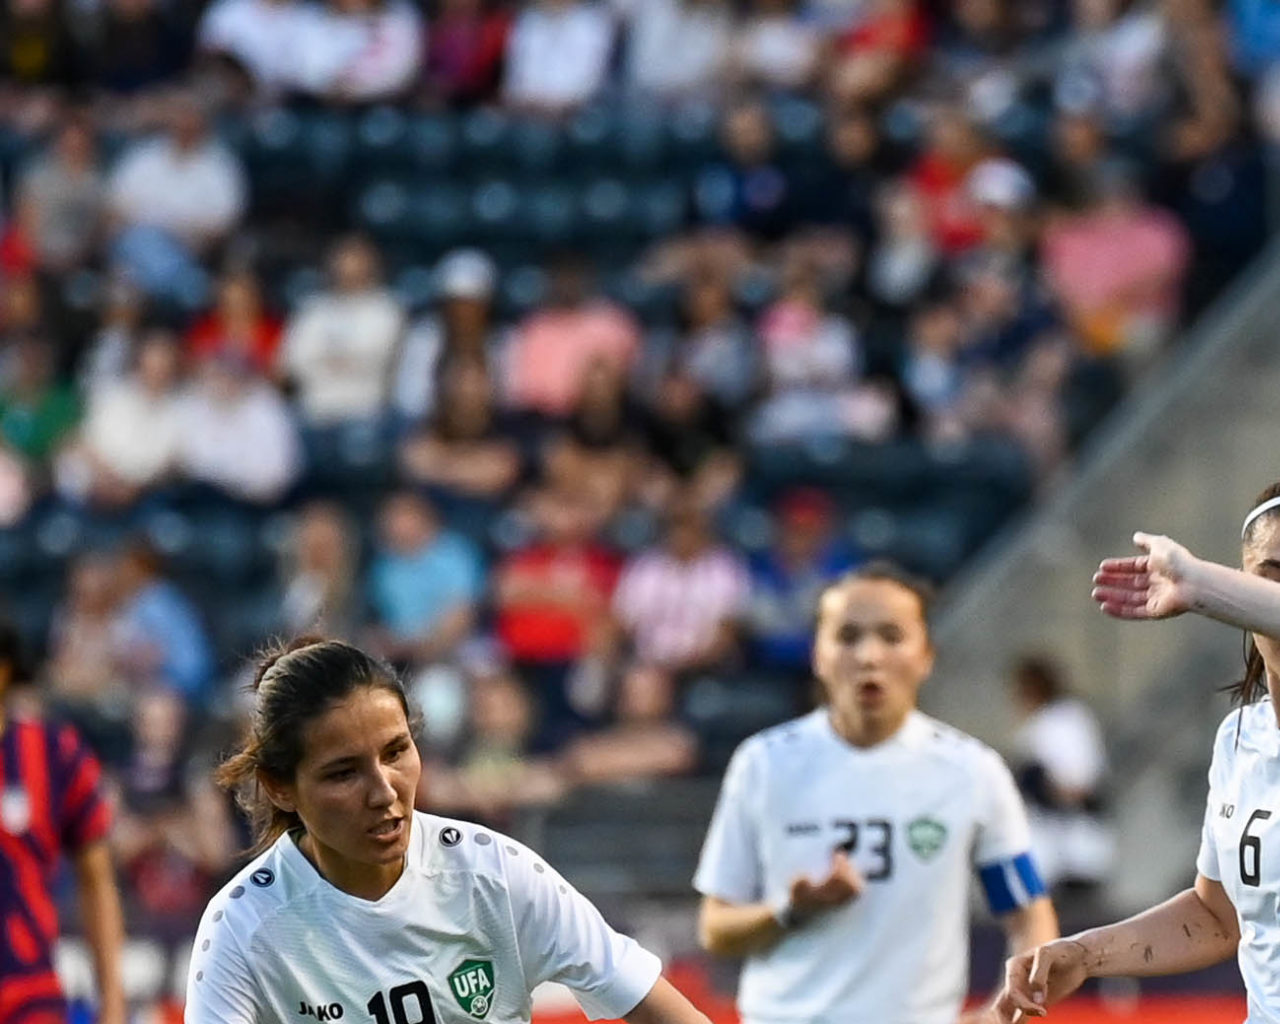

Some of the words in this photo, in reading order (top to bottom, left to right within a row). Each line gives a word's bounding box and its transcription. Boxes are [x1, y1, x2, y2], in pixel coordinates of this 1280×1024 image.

[1219, 803, 1235, 819] KO
[1239, 809, 1272, 887] 6
[453, 968, 491, 998] UFA
[298, 1001, 344, 1021] JAKO
